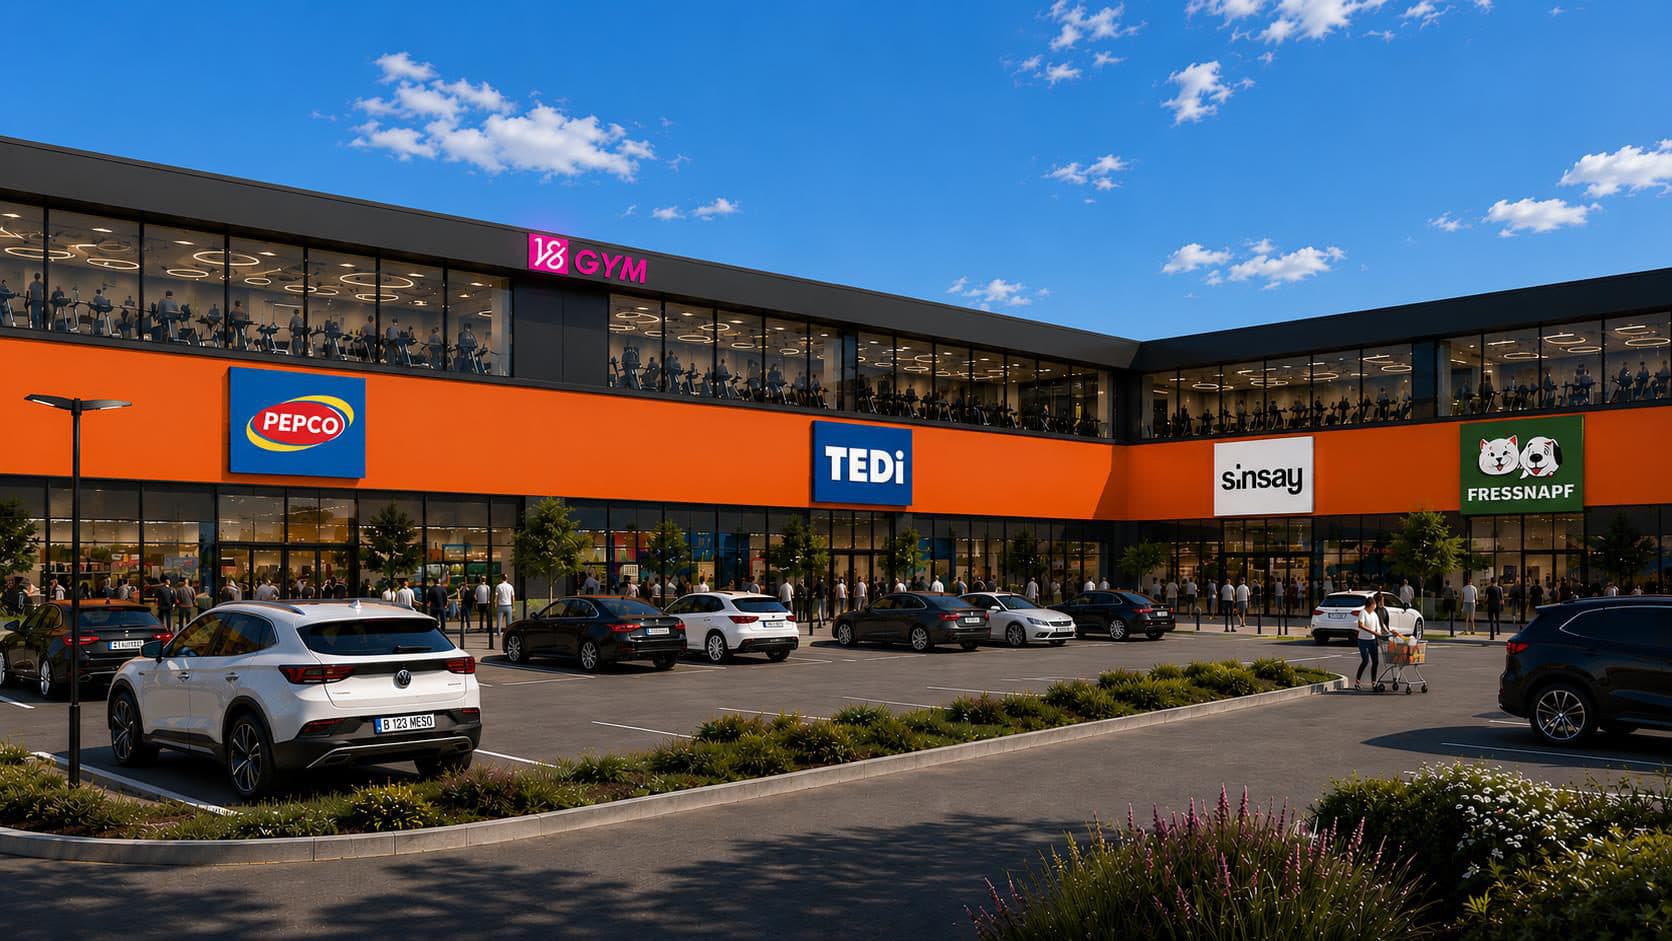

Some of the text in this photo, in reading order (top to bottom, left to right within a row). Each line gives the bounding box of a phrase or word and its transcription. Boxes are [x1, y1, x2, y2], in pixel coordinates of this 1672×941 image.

[575, 249, 647, 284] GYM
[263, 411, 339, 434] PEPCO
[825, 445, 904, 484] TEDi
[1222, 464, 1302, 495] sinsay
[1468, 484, 1575, 501] FRESSNAPF
[383, 715, 432, 730] B 123 MESO
